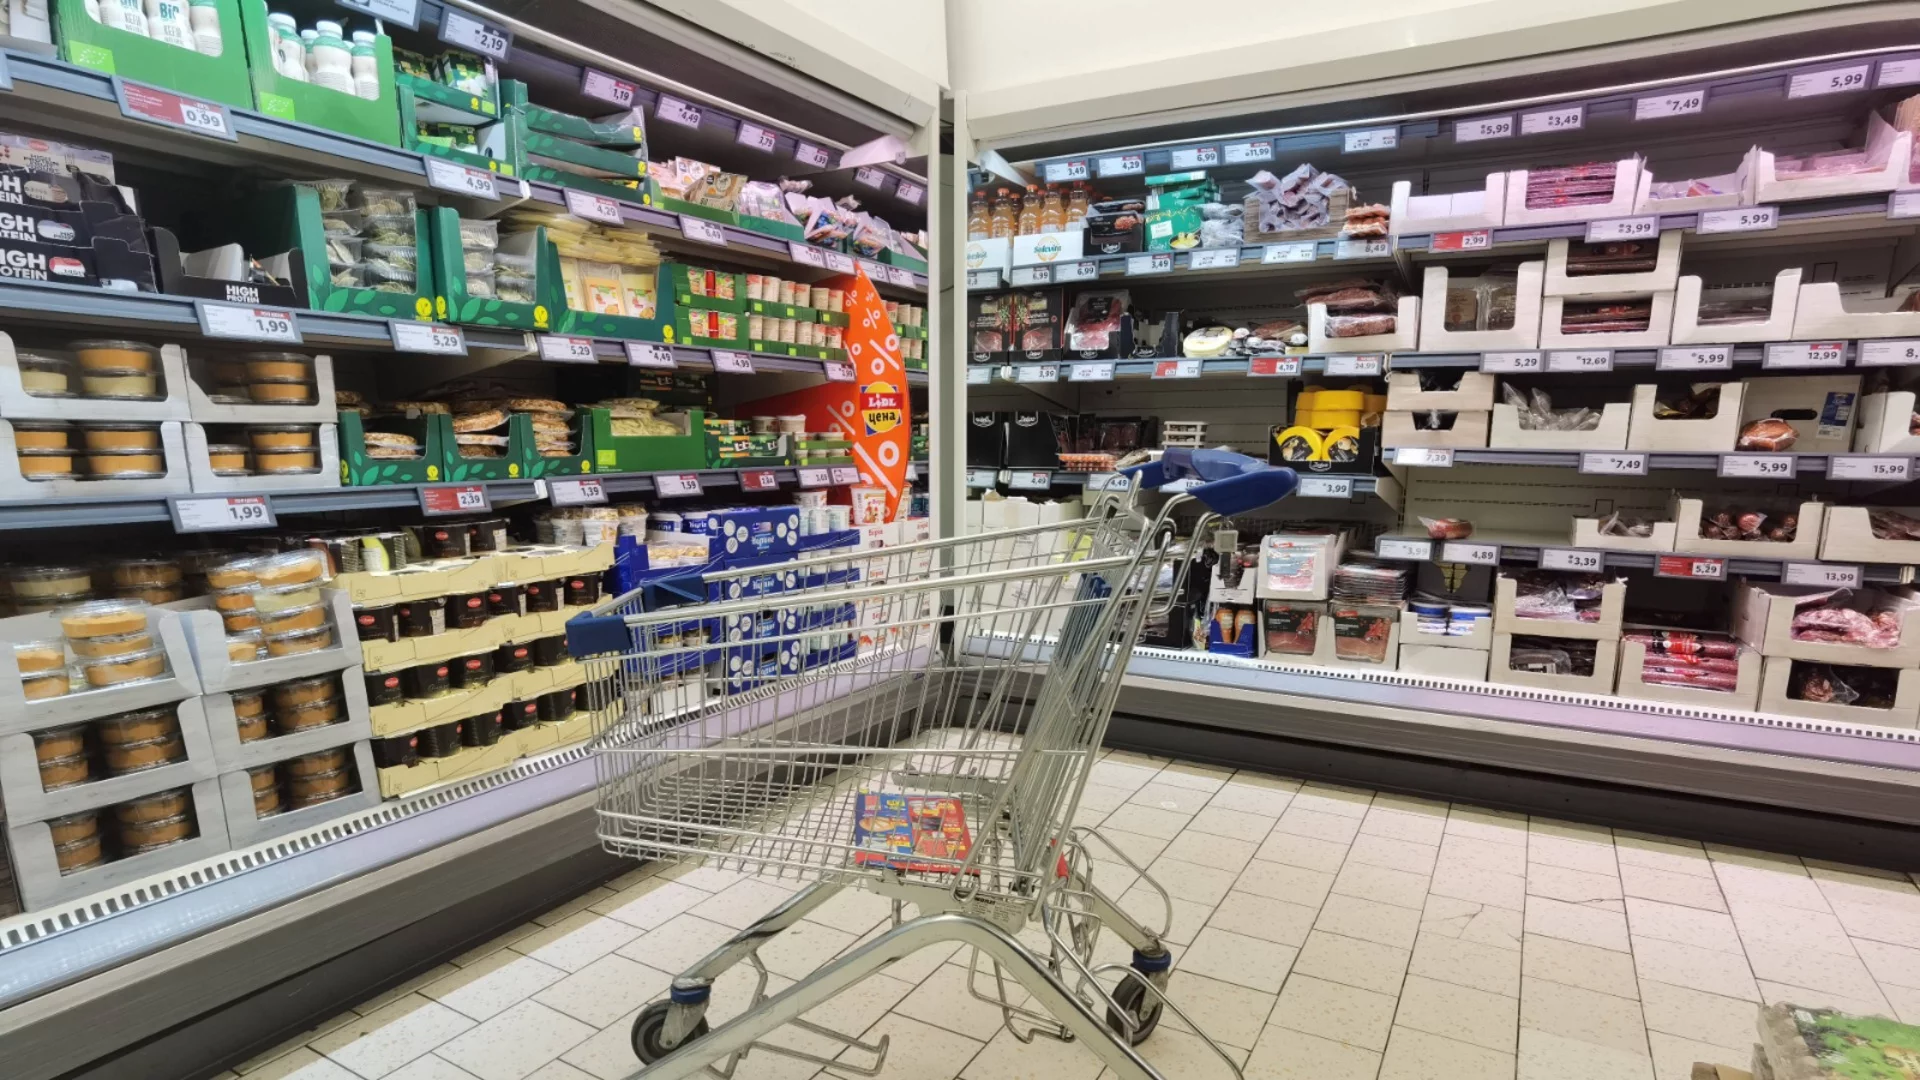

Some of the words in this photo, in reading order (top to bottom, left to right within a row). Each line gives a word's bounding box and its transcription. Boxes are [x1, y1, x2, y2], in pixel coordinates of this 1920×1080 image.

[480, 34, 504, 51] 2,19
[1830, 72, 1863, 88] 5,99
[613, 87, 630, 101] 1,19
[1672, 98, 1699, 111] 7,49
[186, 111, 221, 128] 0,99
[681, 110, 699, 125] 4,49
[1554, 114, 1579, 127] 3,49
[1486, 123, 1510, 136] 5,99
[1196, 153, 1216, 163] 6,99
[1068, 166, 1086, 177] 3,49
[1122, 161, 1140, 171] 4,29
[466, 176, 492, 192] 4,99
[596, 202, 617, 218] 4,29
[1740, 213, 1769, 225] 5,99
[1624, 223, 1651, 235] 3,99
[1364, 243, 1387, 253] 8,49
[1151, 259, 1170, 270] 3,49
[1076, 266, 1095, 277] 6,99
[225, 283, 259, 298] HIGH
[255, 318, 289, 334] 1,99
[432, 334, 458, 348] 5,29
[570, 345, 591, 357] 5,29
[653, 350, 672, 362] 4,49
[1807, 350, 1839, 361] 12,99
[1514, 358, 1538, 368] 5,29
[1581, 356, 1607, 366] 12,69
[1697, 353, 1725, 364] 5,99
[868, 411, 897, 426] цена
[1426, 453, 1447, 463] 7,39
[1616, 459, 1641, 470] 7,49
[1760, 462, 1788, 473] 5,99
[1873, 464, 1905, 474] 15,99
[680, 480, 698, 492] 1,59
[1030, 477, 1047, 486] 4,49
[1110, 478, 1127, 487] 4,49
[581, 487, 600, 499] 1,39
[1327, 484, 1347, 494] 3,99
[460, 493, 481, 505] 2,39
[229, 505, 263, 521] 1,99
[1471, 551, 1494, 560] 4,89
[1574, 557, 1597, 567] 3,39
[1695, 565, 1717, 574] 5,29
[1825, 572, 1854, 582] 13,99
